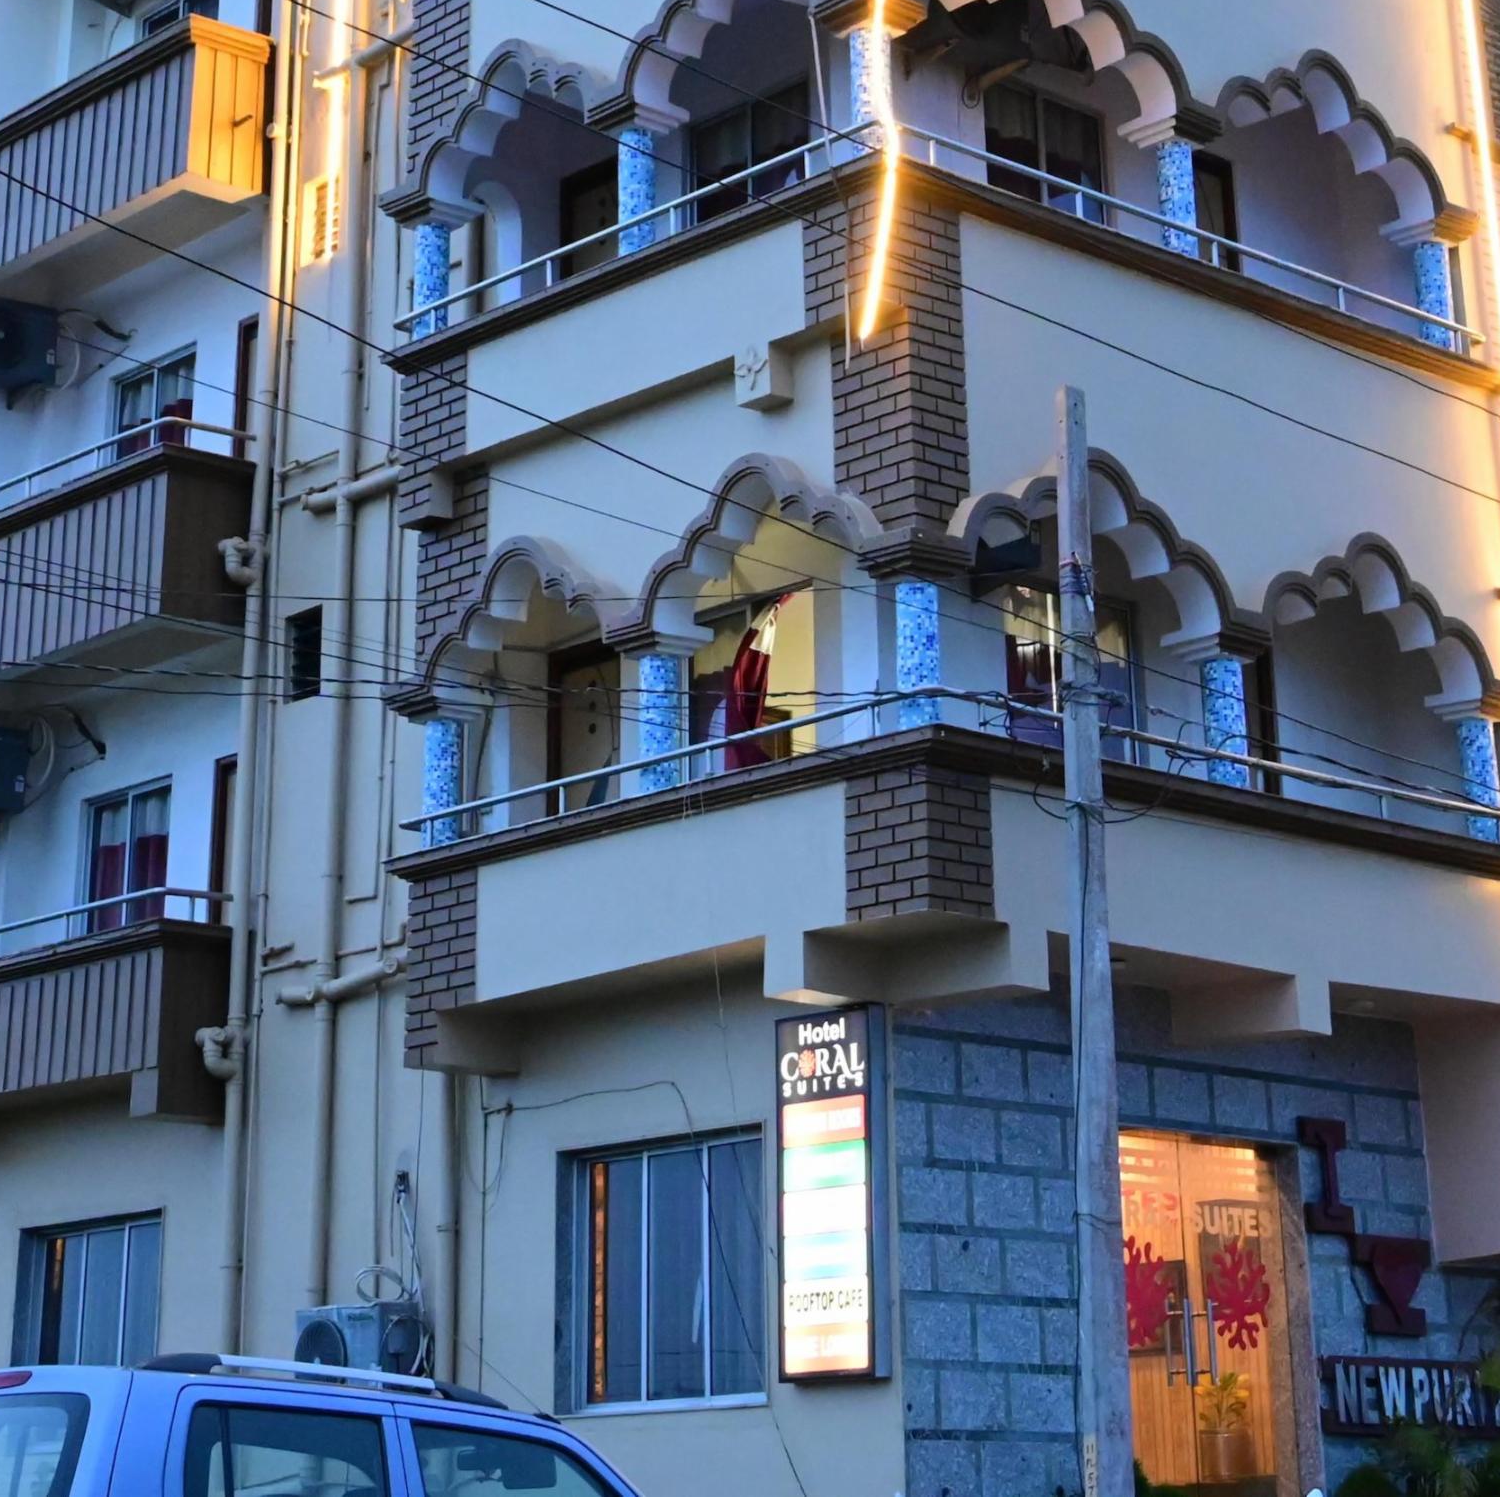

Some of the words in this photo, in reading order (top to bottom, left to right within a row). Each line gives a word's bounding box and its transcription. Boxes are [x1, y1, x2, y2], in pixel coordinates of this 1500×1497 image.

[798, 1016, 846, 1046] Hotel
[782, 1071, 864, 1098] SUITES
[1194, 1204, 1274, 1239] SUITES
[1335, 1361, 1406, 1425] NEW
